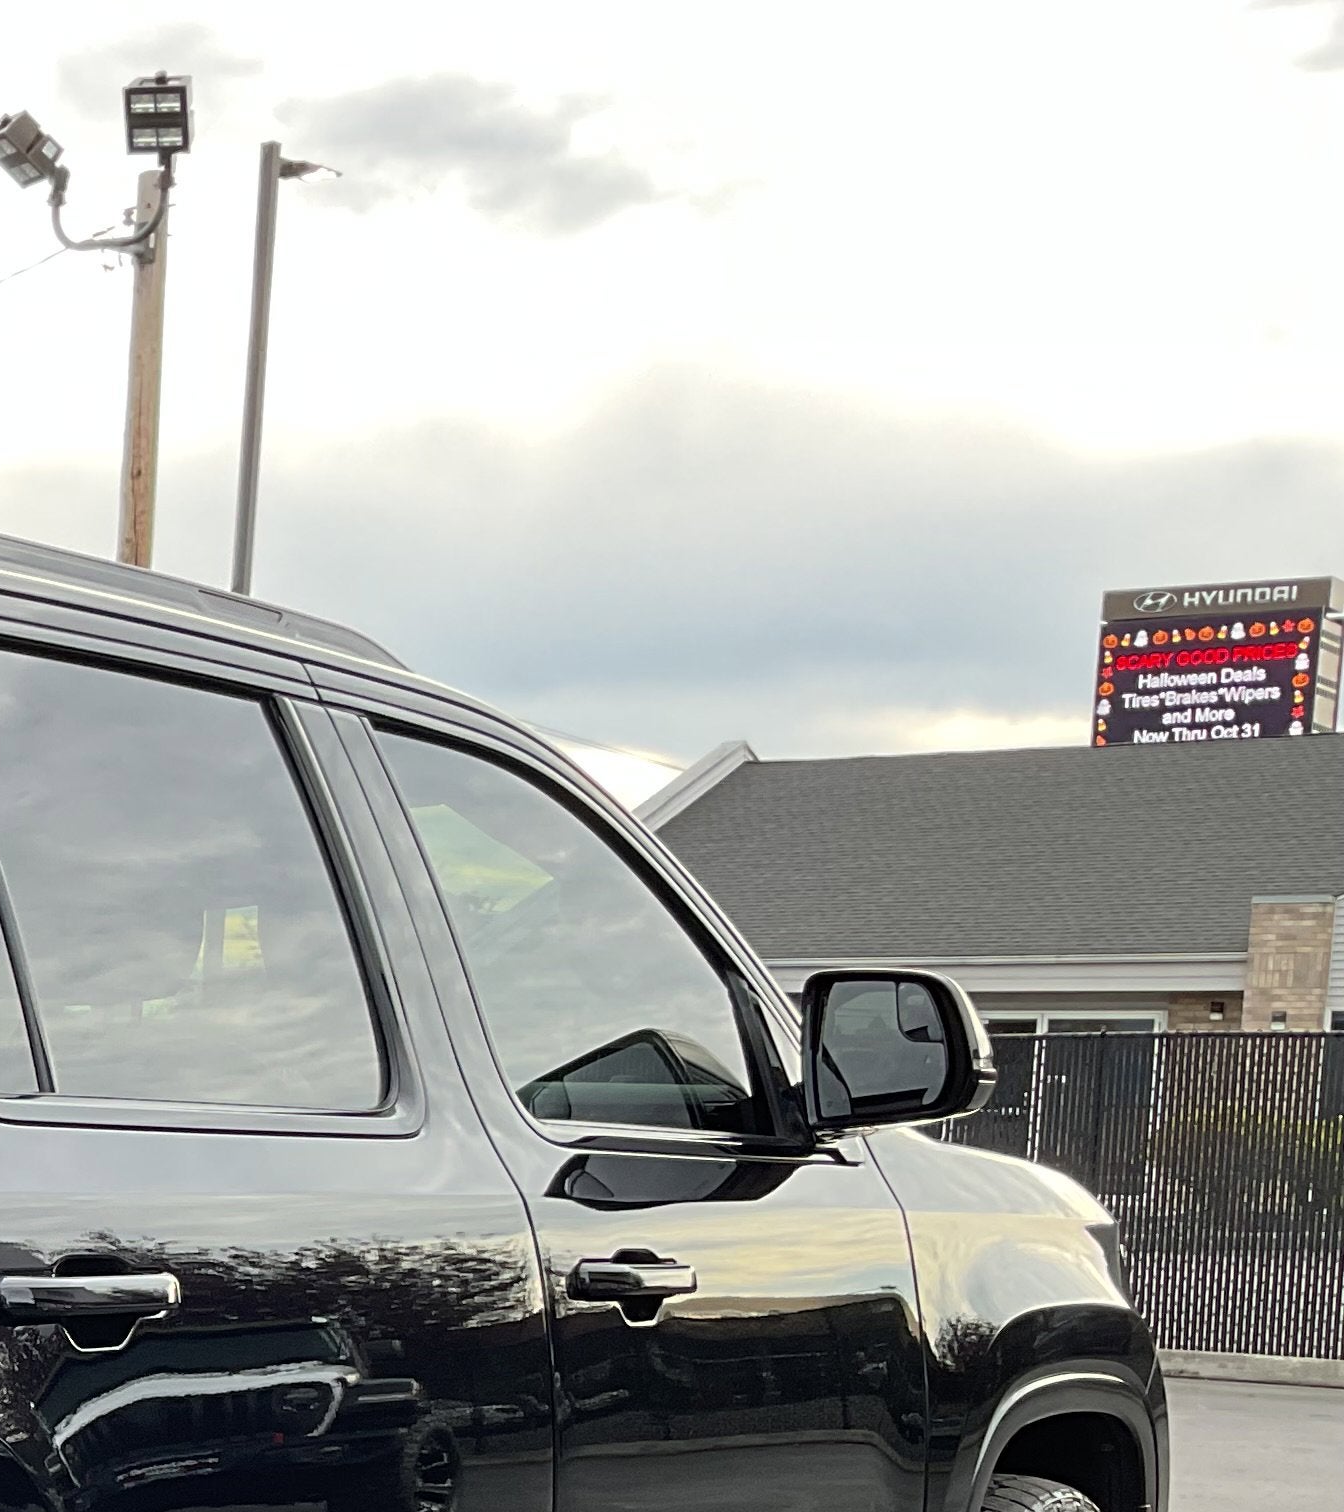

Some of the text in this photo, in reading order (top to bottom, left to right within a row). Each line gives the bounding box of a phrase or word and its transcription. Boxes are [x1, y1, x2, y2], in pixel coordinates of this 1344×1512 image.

[1183, 585, 1298, 607] HYUNDAI
[1116, 652, 1172, 671] SCARY
[1137, 666, 1266, 689] Halloween Deals
[1162, 707, 1235, 725] and More
[1133, 723, 1260, 744] Now Thru Oct 31
